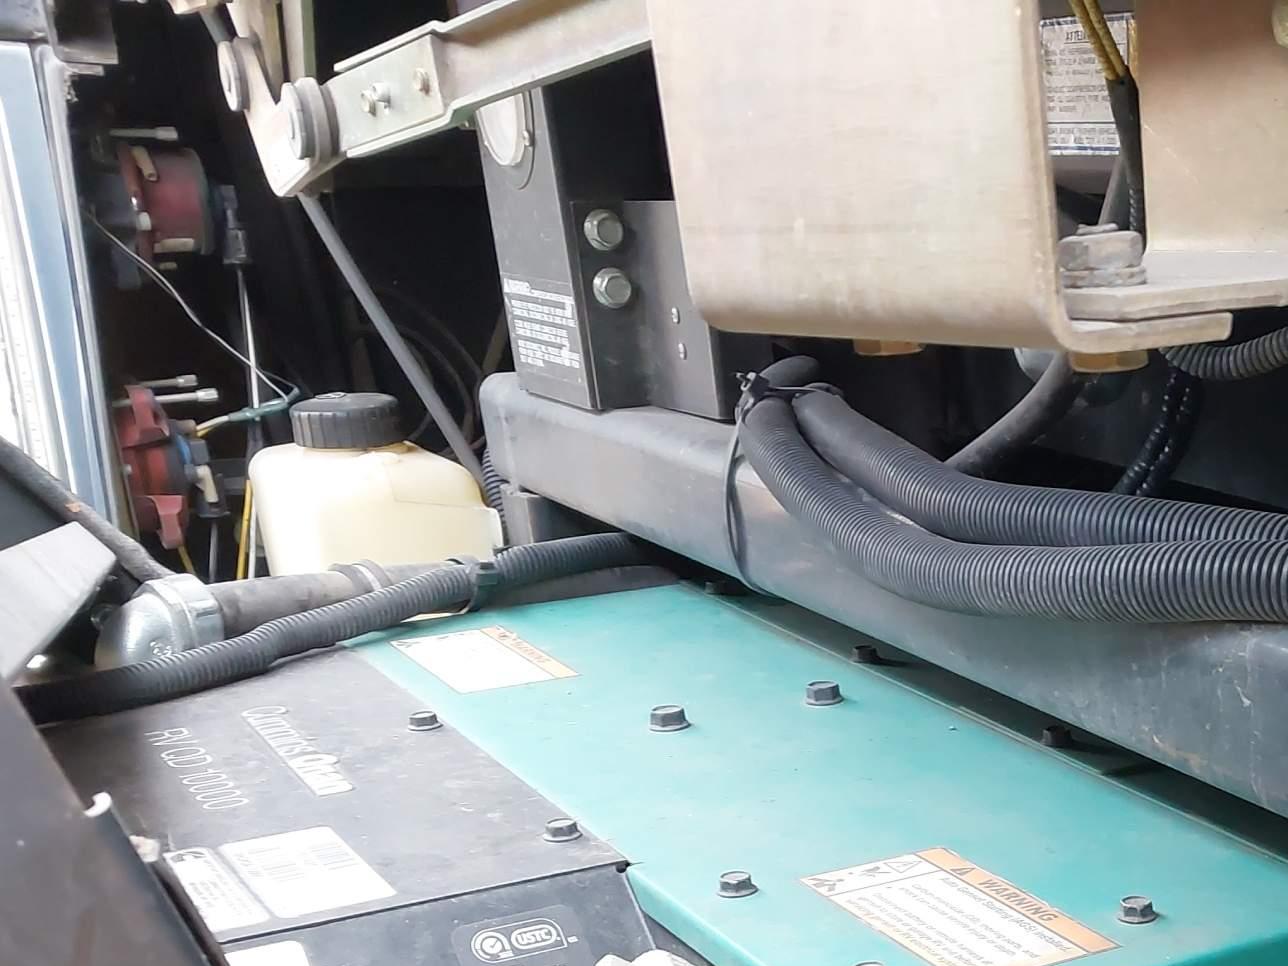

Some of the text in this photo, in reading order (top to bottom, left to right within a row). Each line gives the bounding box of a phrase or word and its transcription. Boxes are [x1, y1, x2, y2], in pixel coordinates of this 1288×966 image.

[144, 727, 199, 746] RV
[160, 746, 213, 768] QD
[241, 705, 315, 757] Cummins
[287, 753, 353, 797] Onan
[178, 768, 250, 810] 10000
[978, 879, 1058, 922] WARNING
